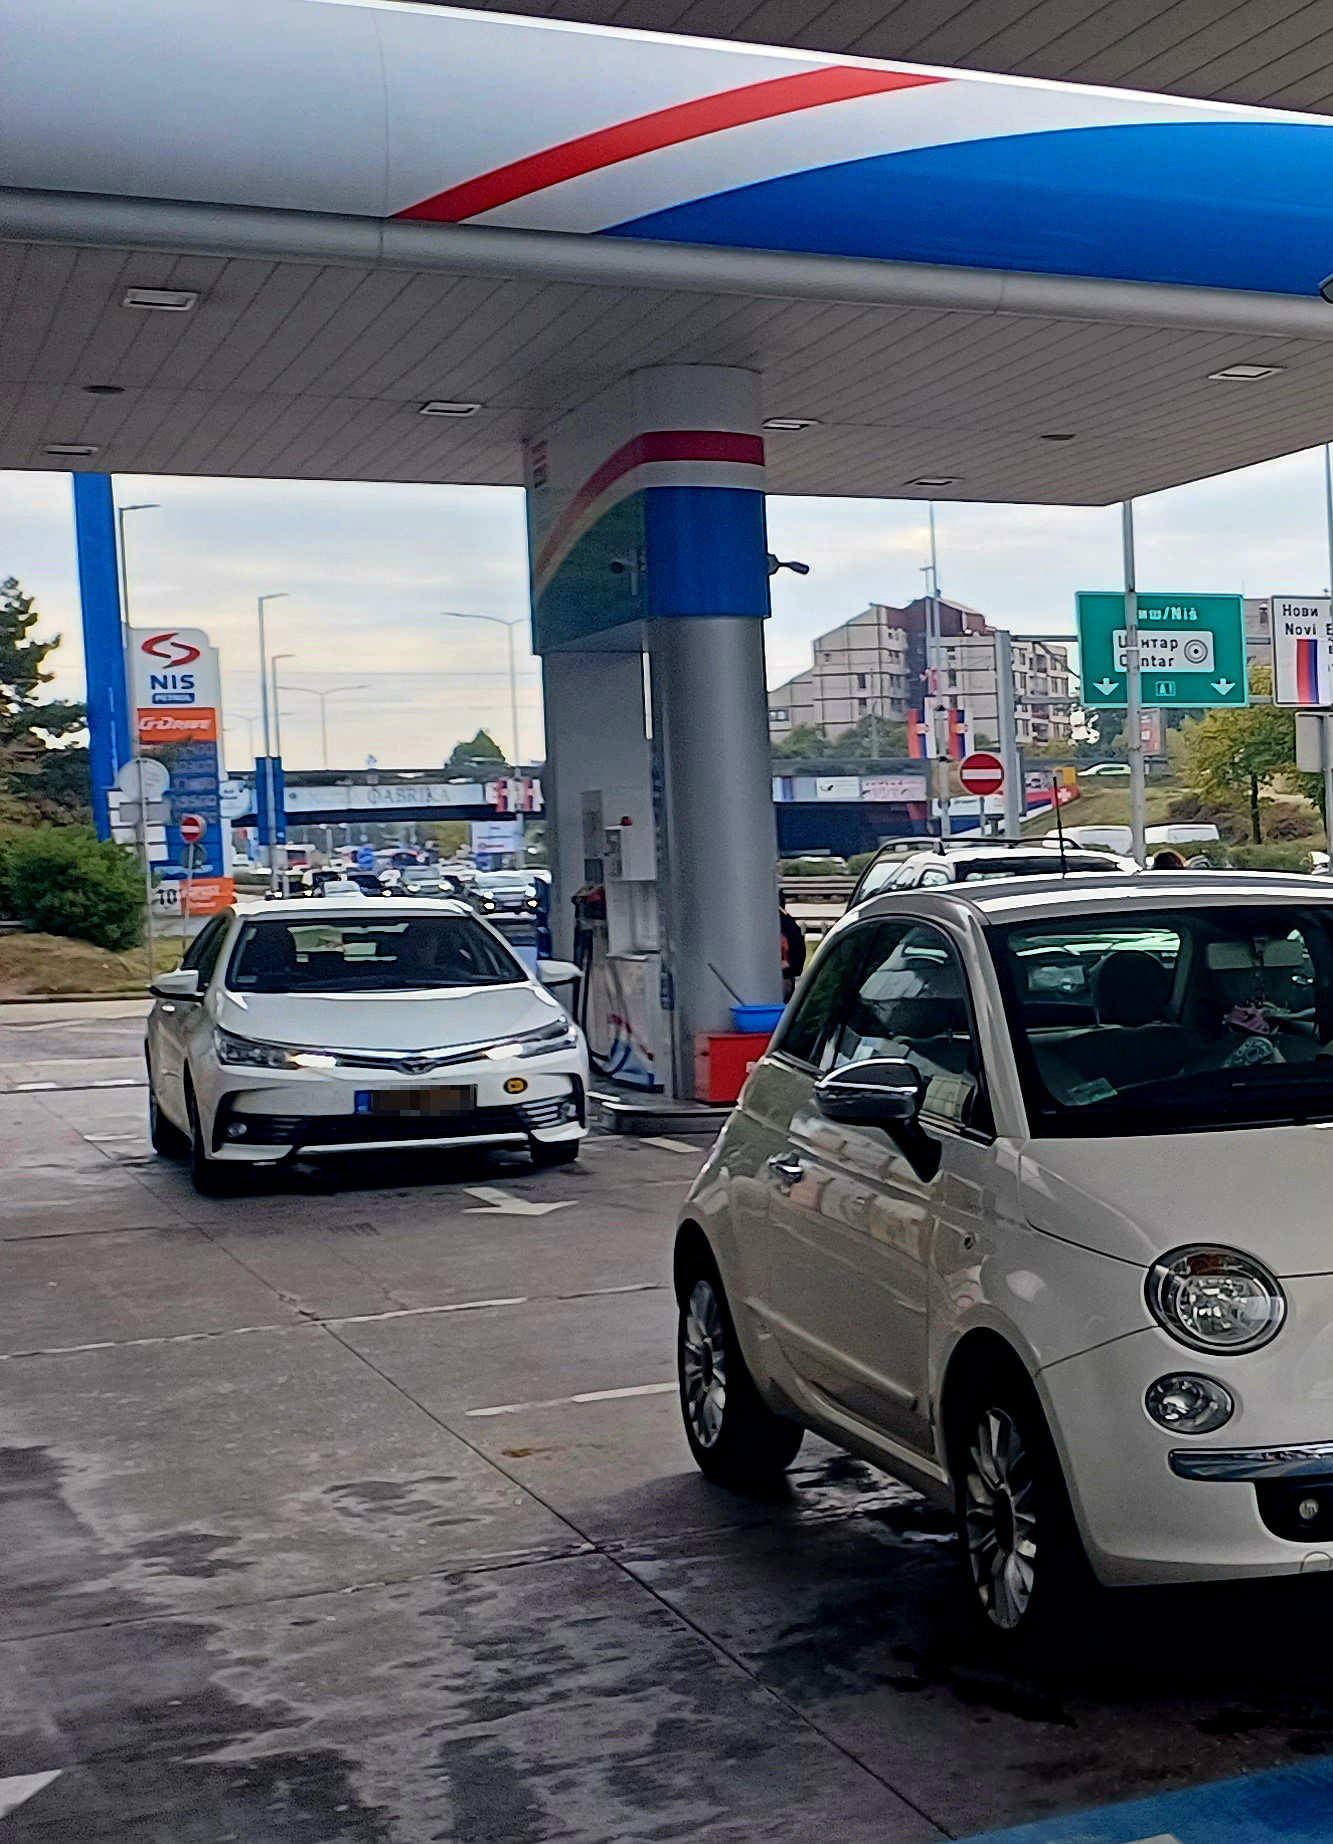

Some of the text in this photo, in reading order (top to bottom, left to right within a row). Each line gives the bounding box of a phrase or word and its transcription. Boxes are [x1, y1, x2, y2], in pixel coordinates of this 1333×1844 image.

[1137, 605, 1198, 621] иш/Niš
[1282, 604, 1319, 617] Нови
[1285, 623, 1317, 636] Novi
[1118, 635, 1179, 652] Цнтар
[1119, 654, 1175, 668] Cntar
[150, 674, 195, 690] NIS
[155, 888, 178, 905] 10
